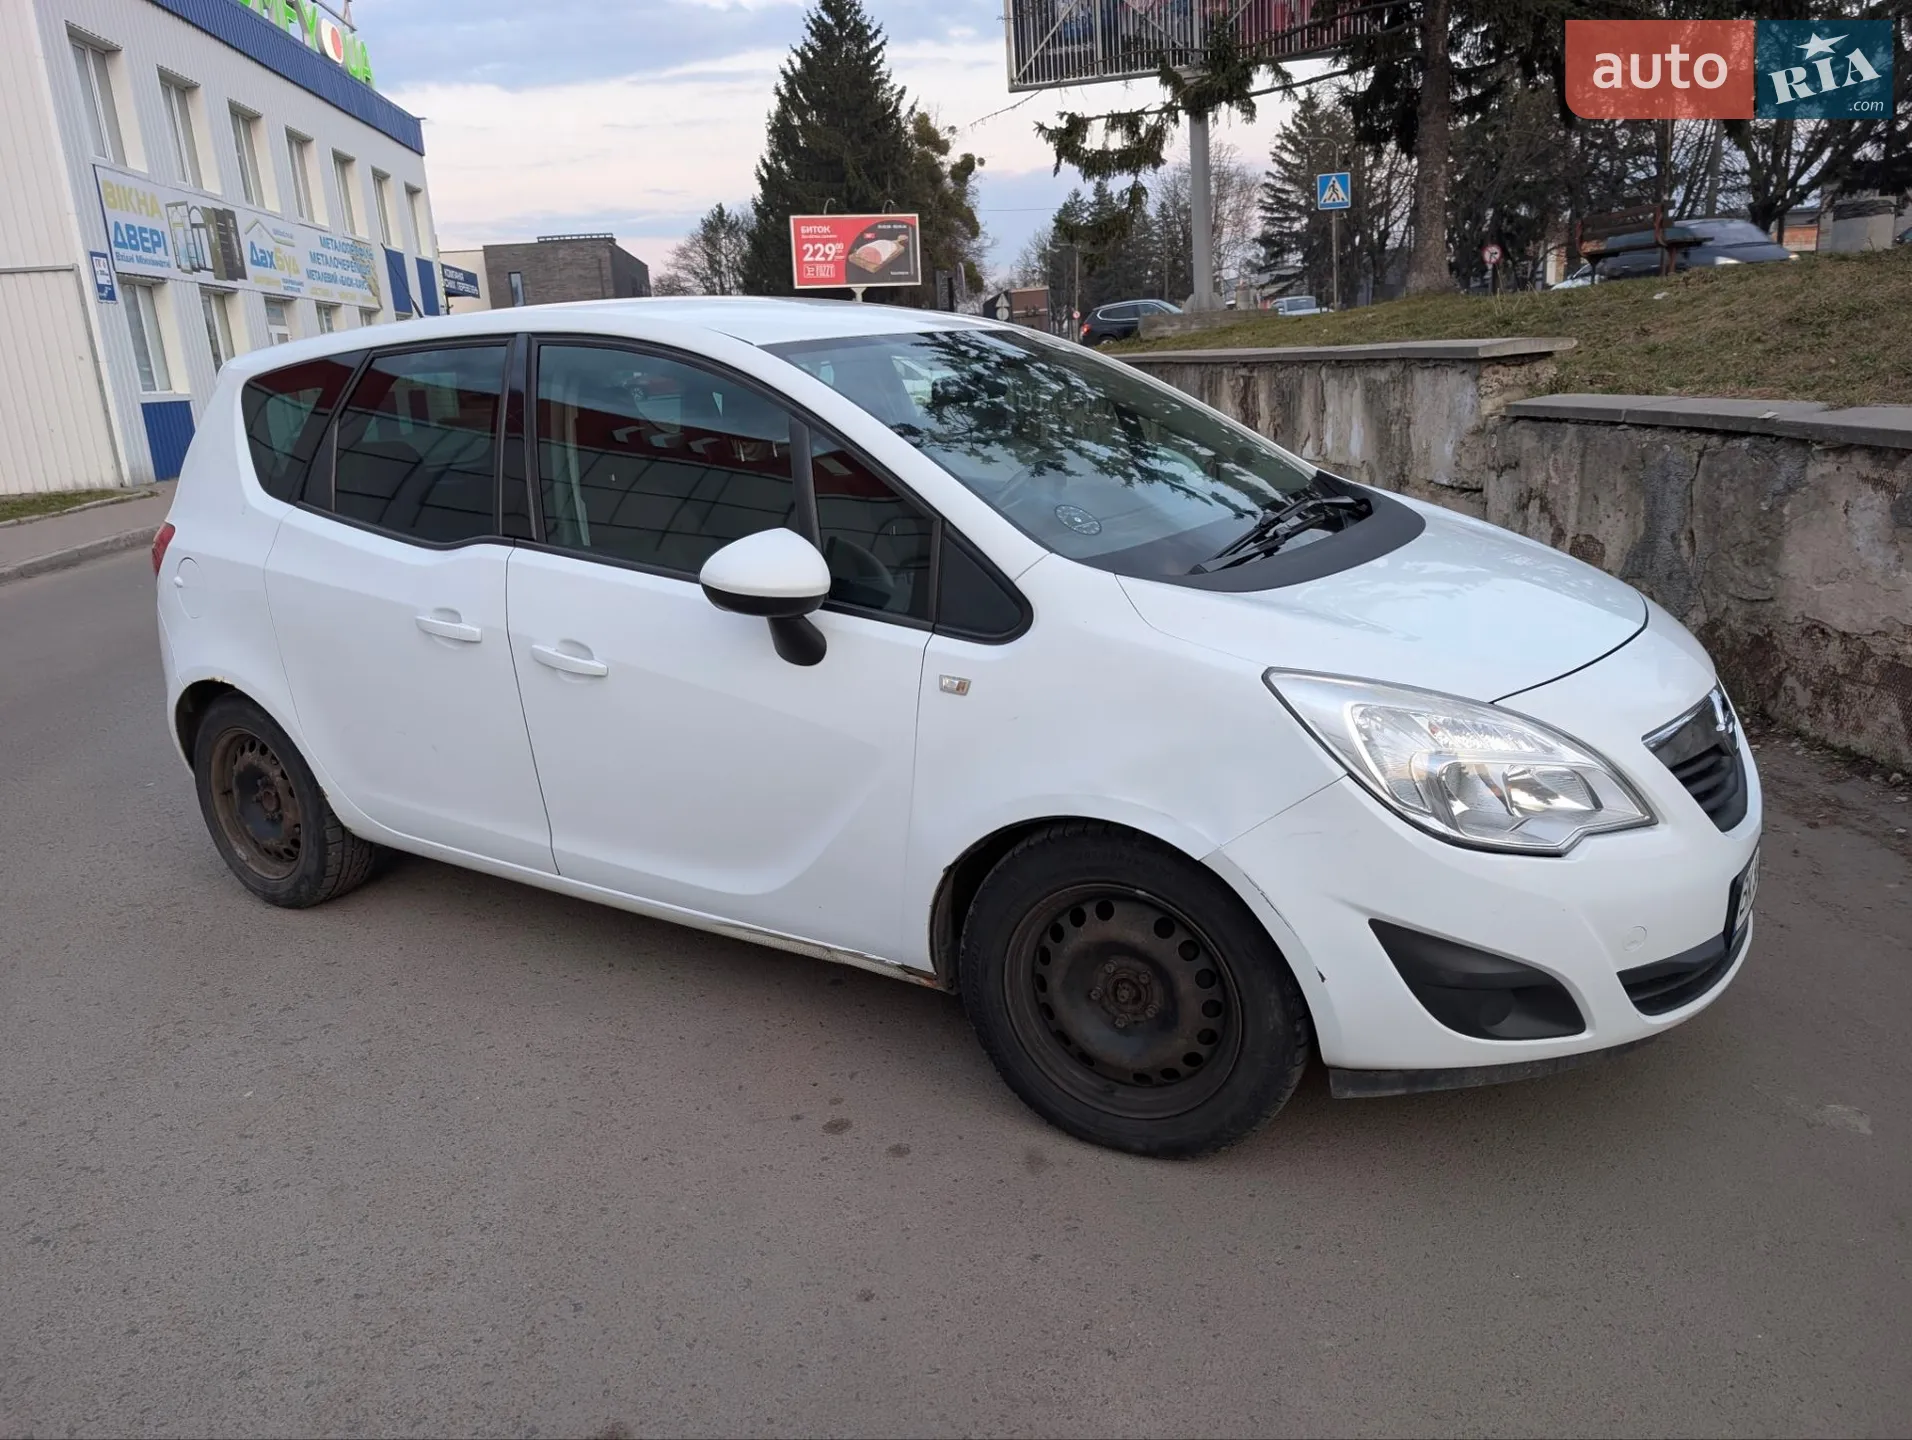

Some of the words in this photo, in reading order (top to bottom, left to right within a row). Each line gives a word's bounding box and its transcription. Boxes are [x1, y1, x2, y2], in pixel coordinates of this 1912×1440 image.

[102, 179, 163, 220] ВІКНА
[113, 221, 169, 257] ДВЕРІ
[800, 225, 831, 234] БИТОК
[802, 243, 836, 262] 229
